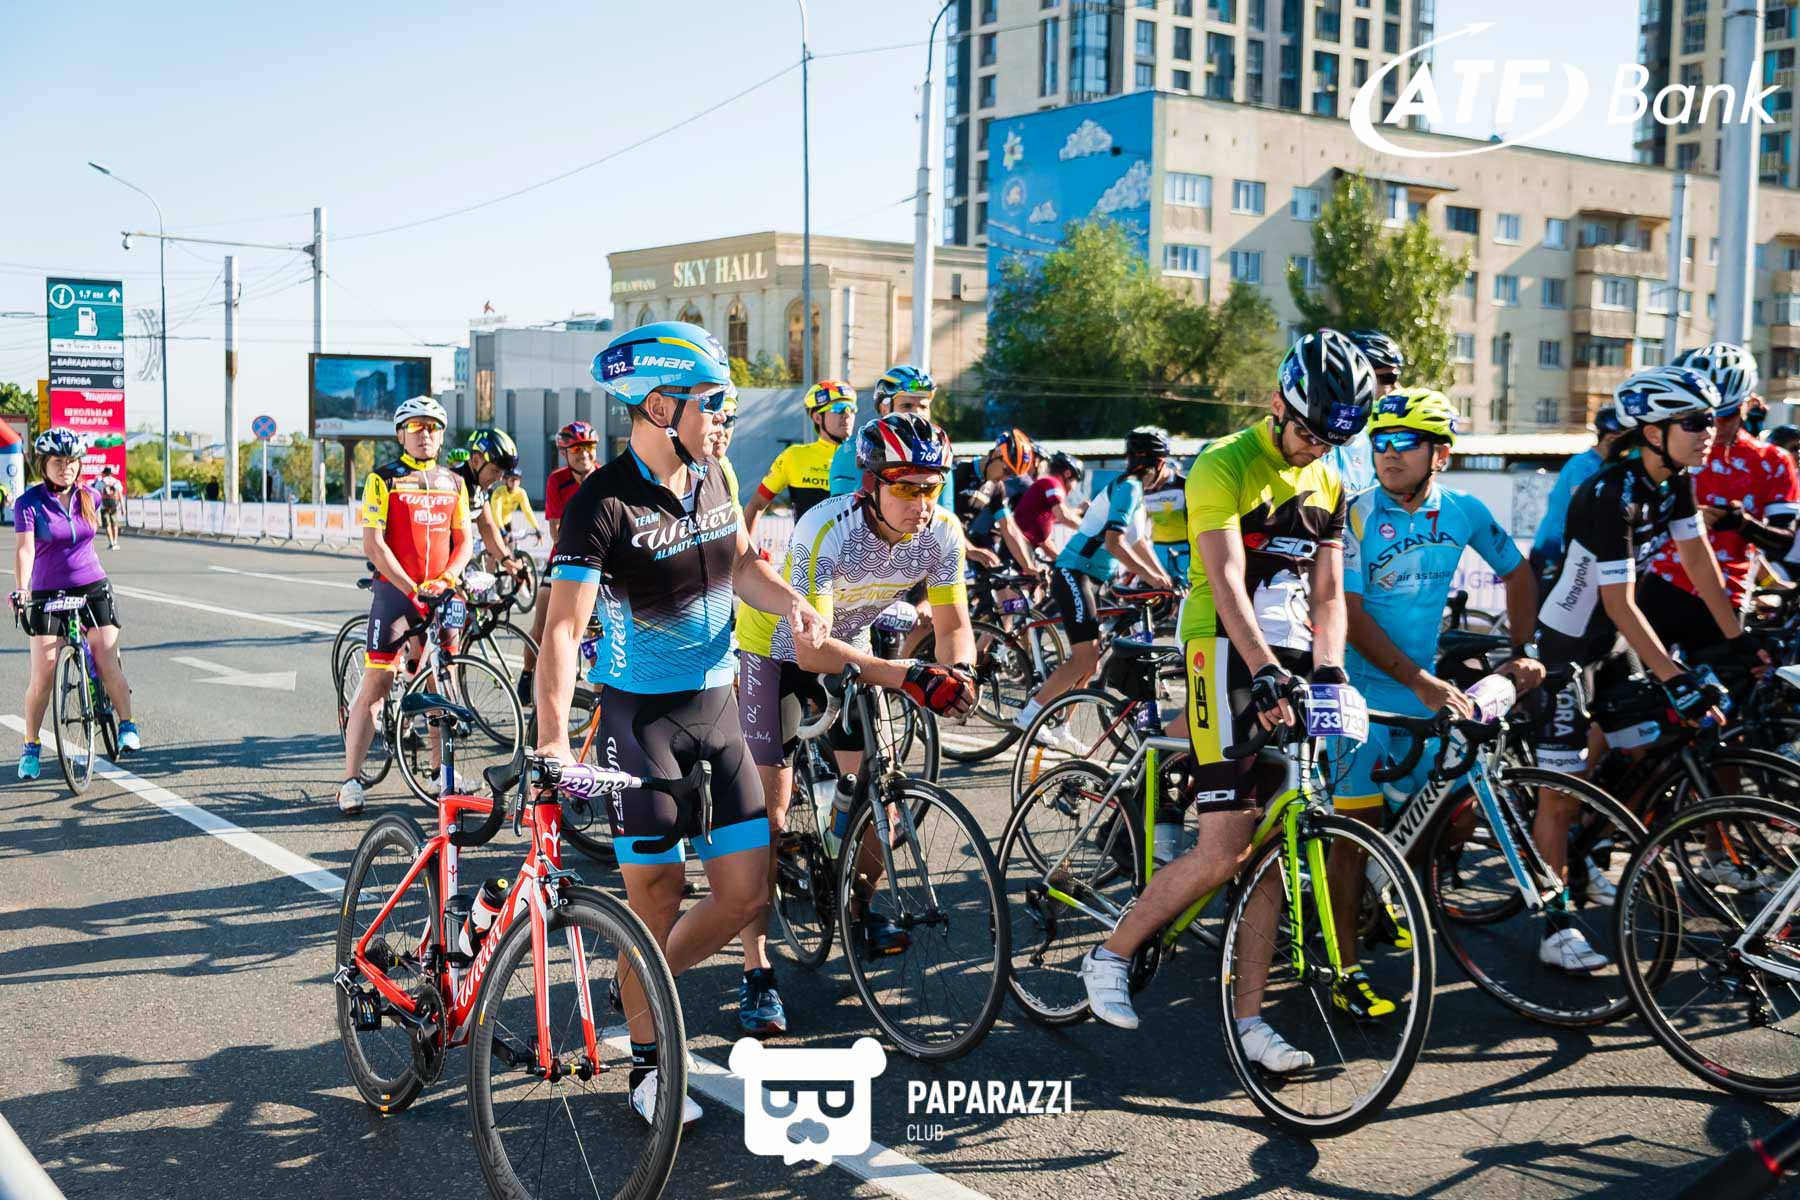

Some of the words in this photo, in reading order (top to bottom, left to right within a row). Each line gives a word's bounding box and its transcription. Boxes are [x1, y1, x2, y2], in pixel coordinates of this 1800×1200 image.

[673, 258, 710, 288] SKY
[714, 251, 769, 284] HALL
[607, 361, 627, 376] 732
[920, 451, 938, 463] 769
[631, 507, 735, 550] Wilier
[635, 512, 660, 528] TEAM
[1368, 531, 1459, 581] ASTANA
[1397, 571, 1410, 581] air
[1555, 555, 1591, 612] hansgrohe
[1193, 675, 1209, 730] SIDI
[1311, 711, 1342, 729] 733
[559, 777, 591, 794] 732
[1196, 788, 1236, 804] SIDI
